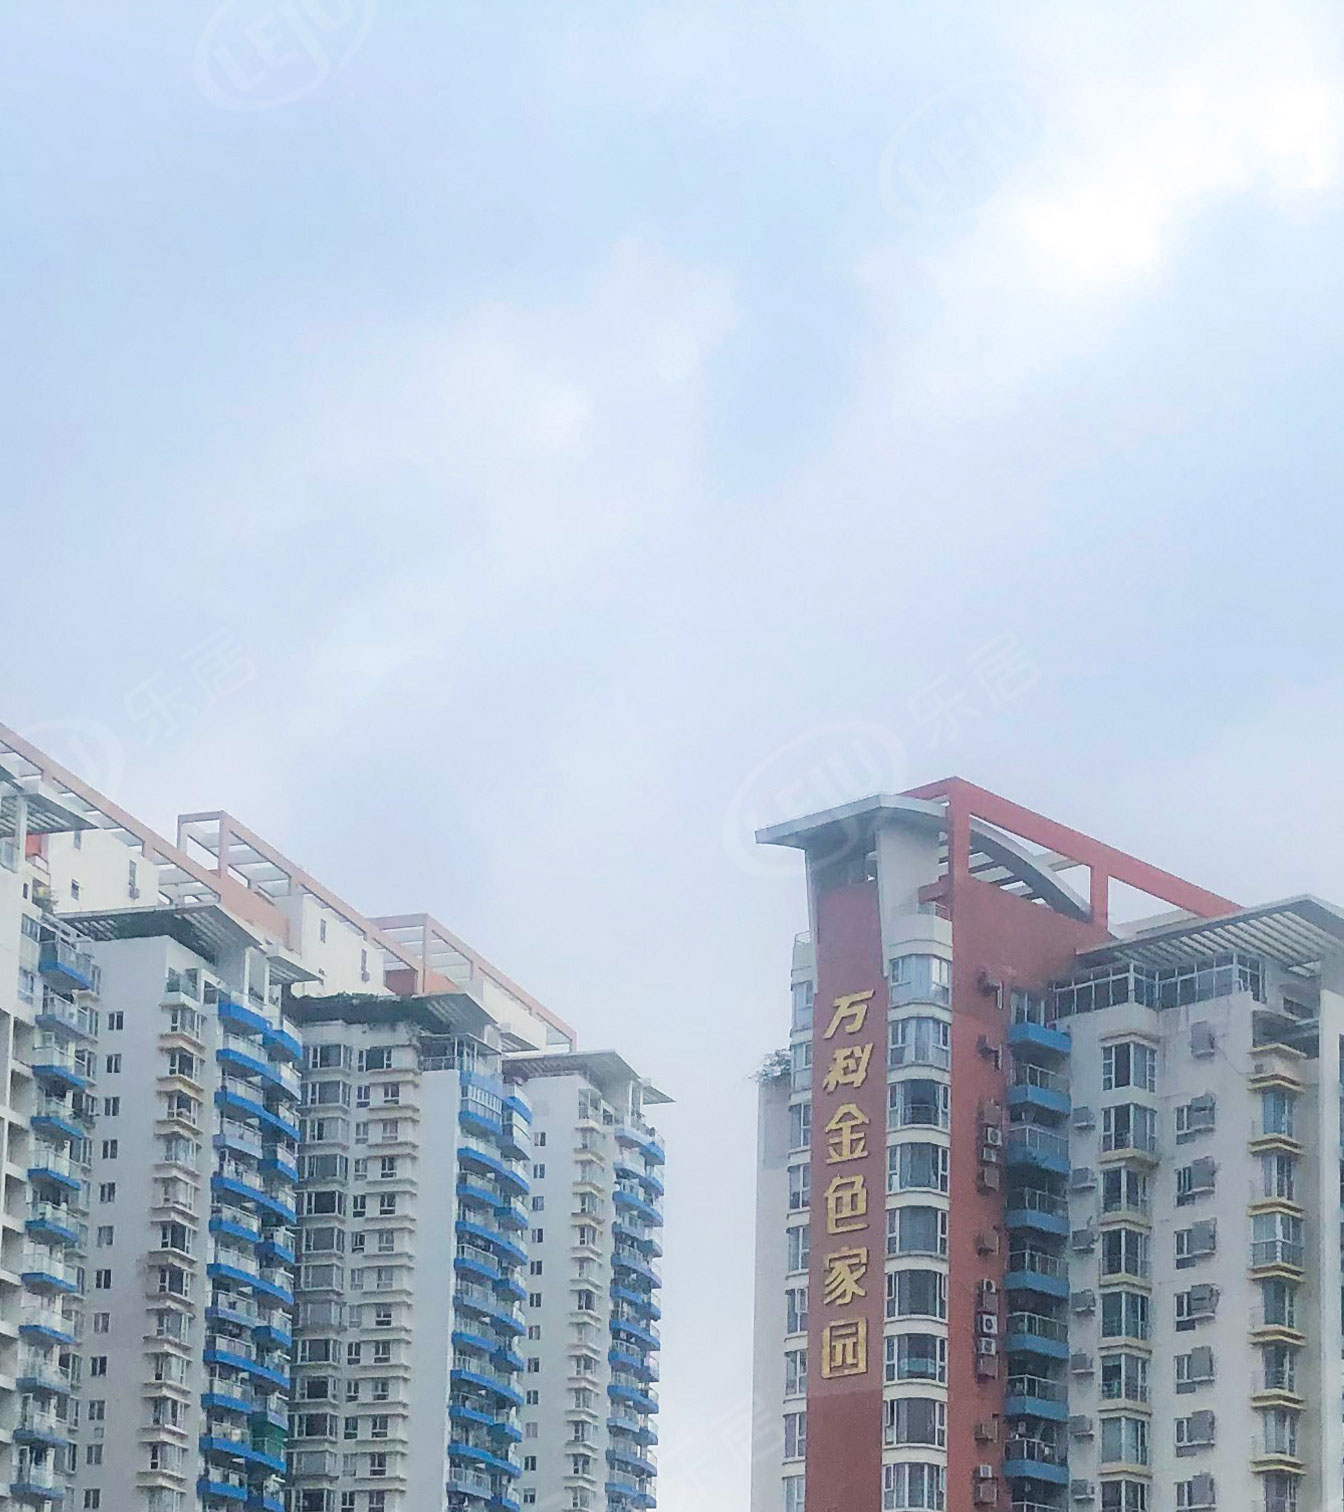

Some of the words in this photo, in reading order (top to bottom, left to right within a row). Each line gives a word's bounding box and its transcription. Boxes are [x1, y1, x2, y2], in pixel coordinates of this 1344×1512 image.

[822, 988, 875, 1379] 万科金色家园
